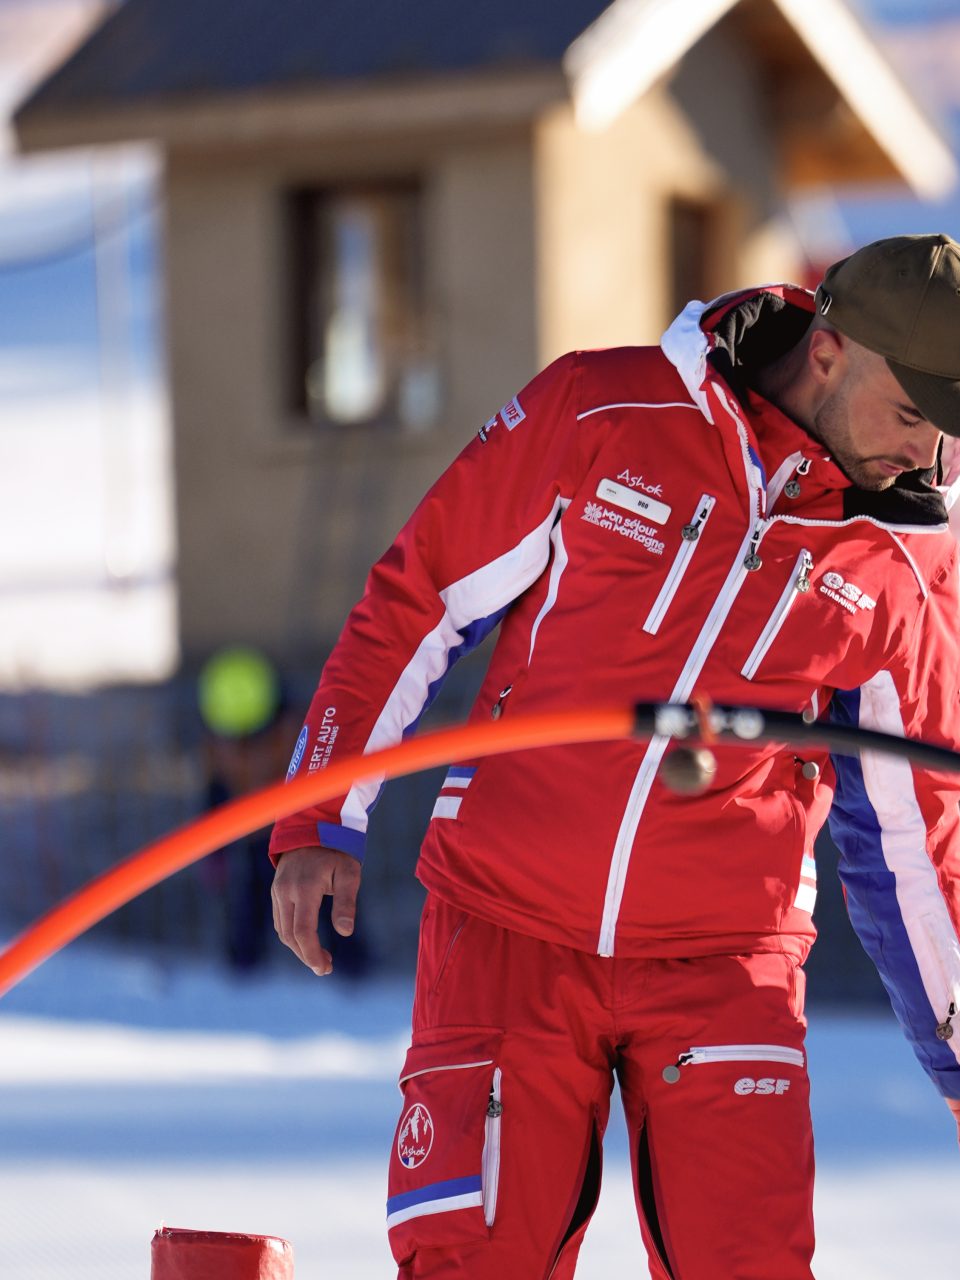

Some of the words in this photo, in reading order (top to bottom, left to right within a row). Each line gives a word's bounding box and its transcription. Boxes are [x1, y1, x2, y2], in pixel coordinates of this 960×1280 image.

[617, 469, 663, 498] Ashok
[600, 519, 613, 530] en
[612, 522, 665, 549] Montagne
[602, 508, 622, 524] Mon
[624, 518, 658, 537] séjour
[317, 707, 336, 743] AUTO
[328, 726, 339, 745] BAINS
[401, 1145, 426, 1158] Ashok
